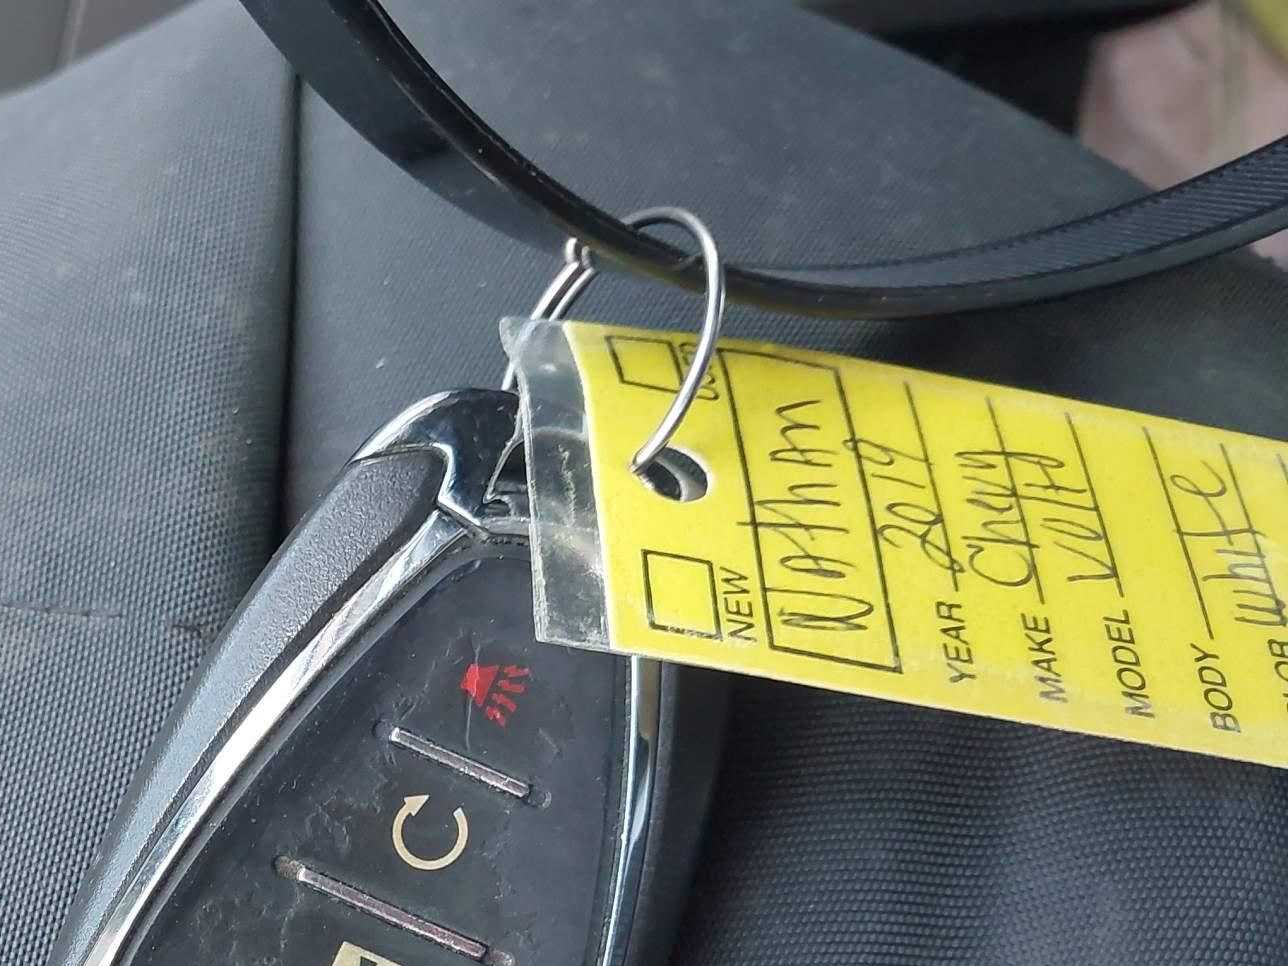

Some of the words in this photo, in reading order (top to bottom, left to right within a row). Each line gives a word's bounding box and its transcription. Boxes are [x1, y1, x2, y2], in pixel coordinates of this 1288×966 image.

[842, 437, 967, 574] 2019
[718, 565, 758, 643] NEW
[935, 600, 977, 684] YEAR
[1021, 612, 1068, 704] MAKE
[1103, 608, 1157, 718] MODEL
[1190, 642, 1242, 734] BODY
